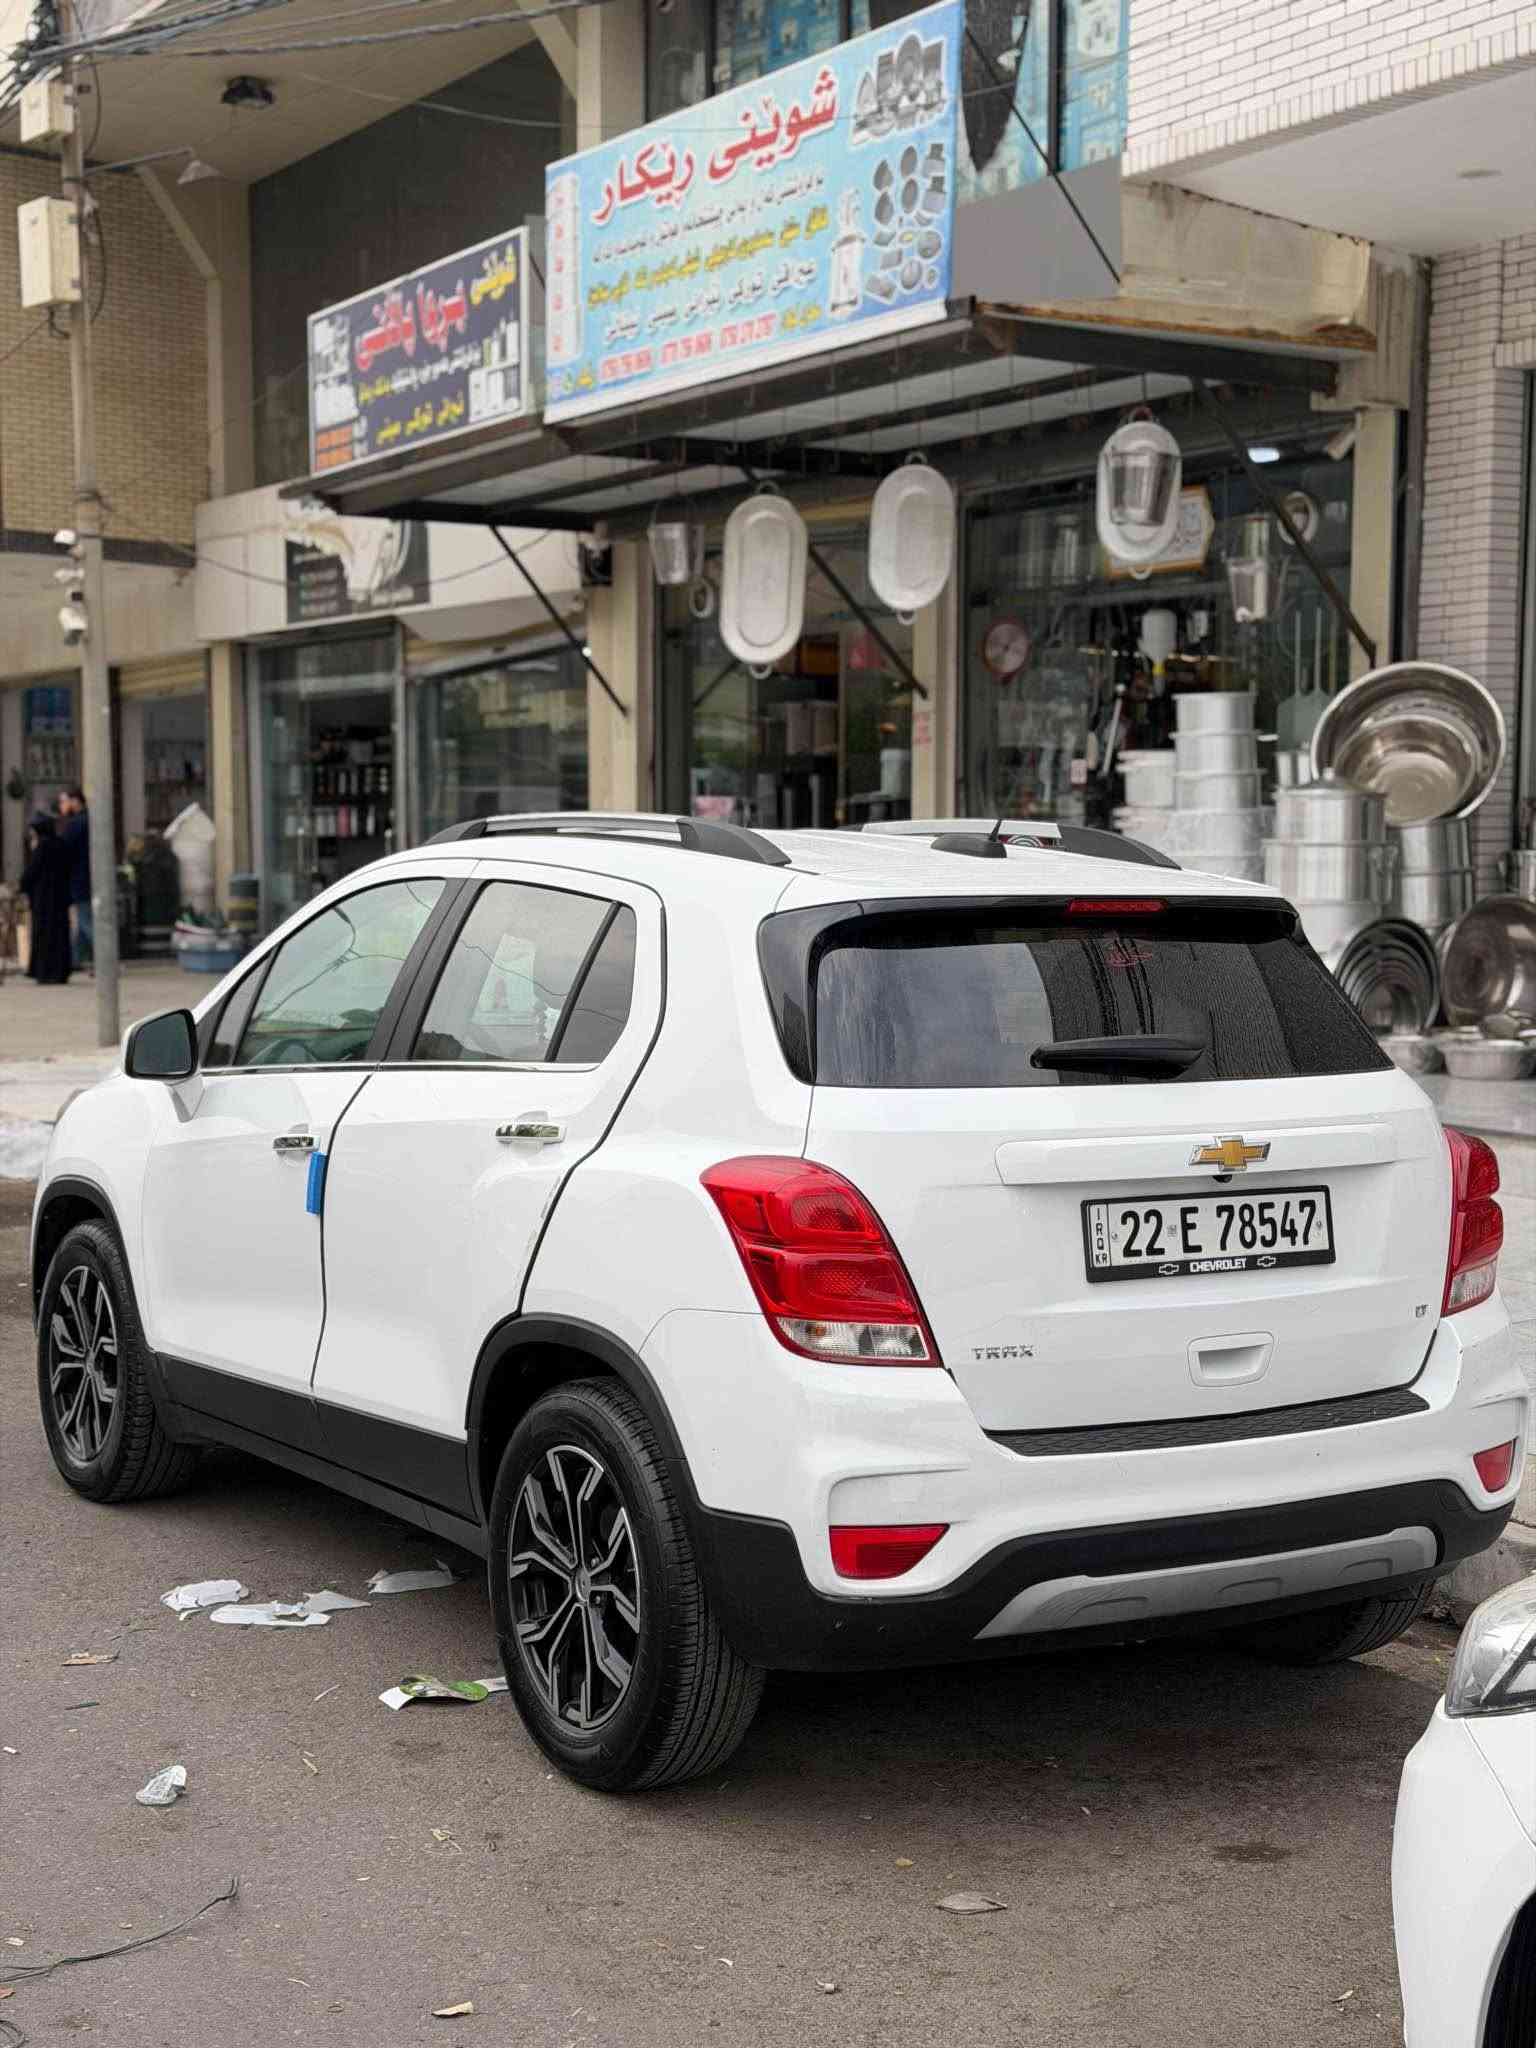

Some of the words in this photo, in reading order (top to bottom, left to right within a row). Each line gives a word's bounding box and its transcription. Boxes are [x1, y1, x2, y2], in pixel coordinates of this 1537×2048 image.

[1121, 1208, 1165, 1258] 22
[1180, 1206, 1203, 1254] E
[1216, 1198, 1317, 1252] 78547
[1190, 1257, 1247, 1273] CHEVROLET
[971, 1345, 1034, 1360] TRAX
